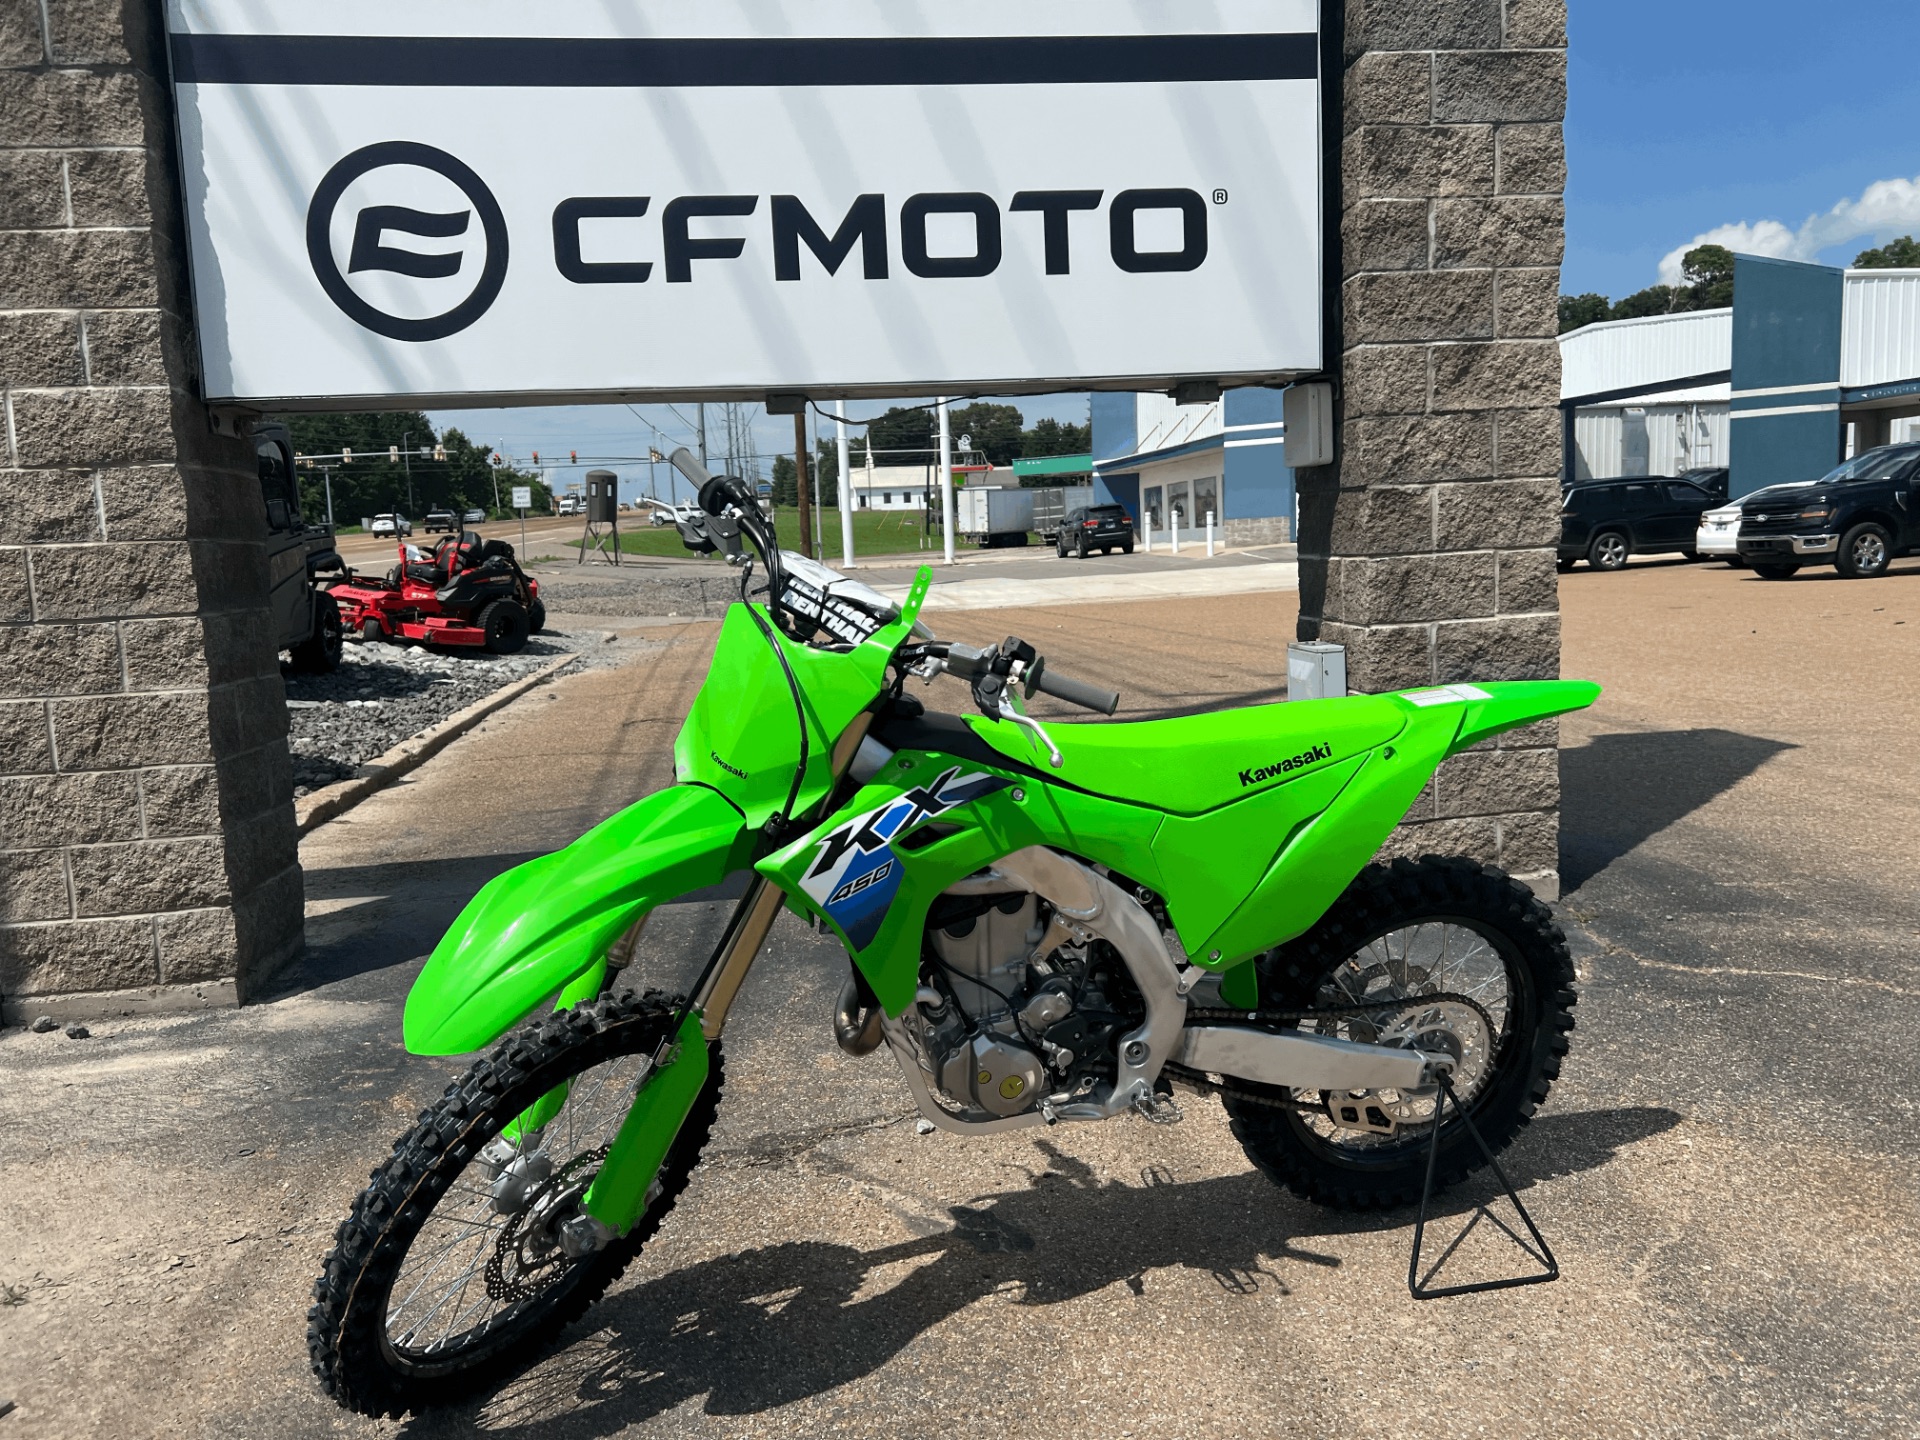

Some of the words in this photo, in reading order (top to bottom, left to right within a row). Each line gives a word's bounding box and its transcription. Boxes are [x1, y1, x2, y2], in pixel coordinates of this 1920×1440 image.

[552, 187, 1208, 284] CFMOTO
[710, 750, 749, 780] Kawasaki
[1238, 742, 1333, 788] Kawasaki
[808, 765, 962, 881] KX
[828, 857, 895, 906] 450
